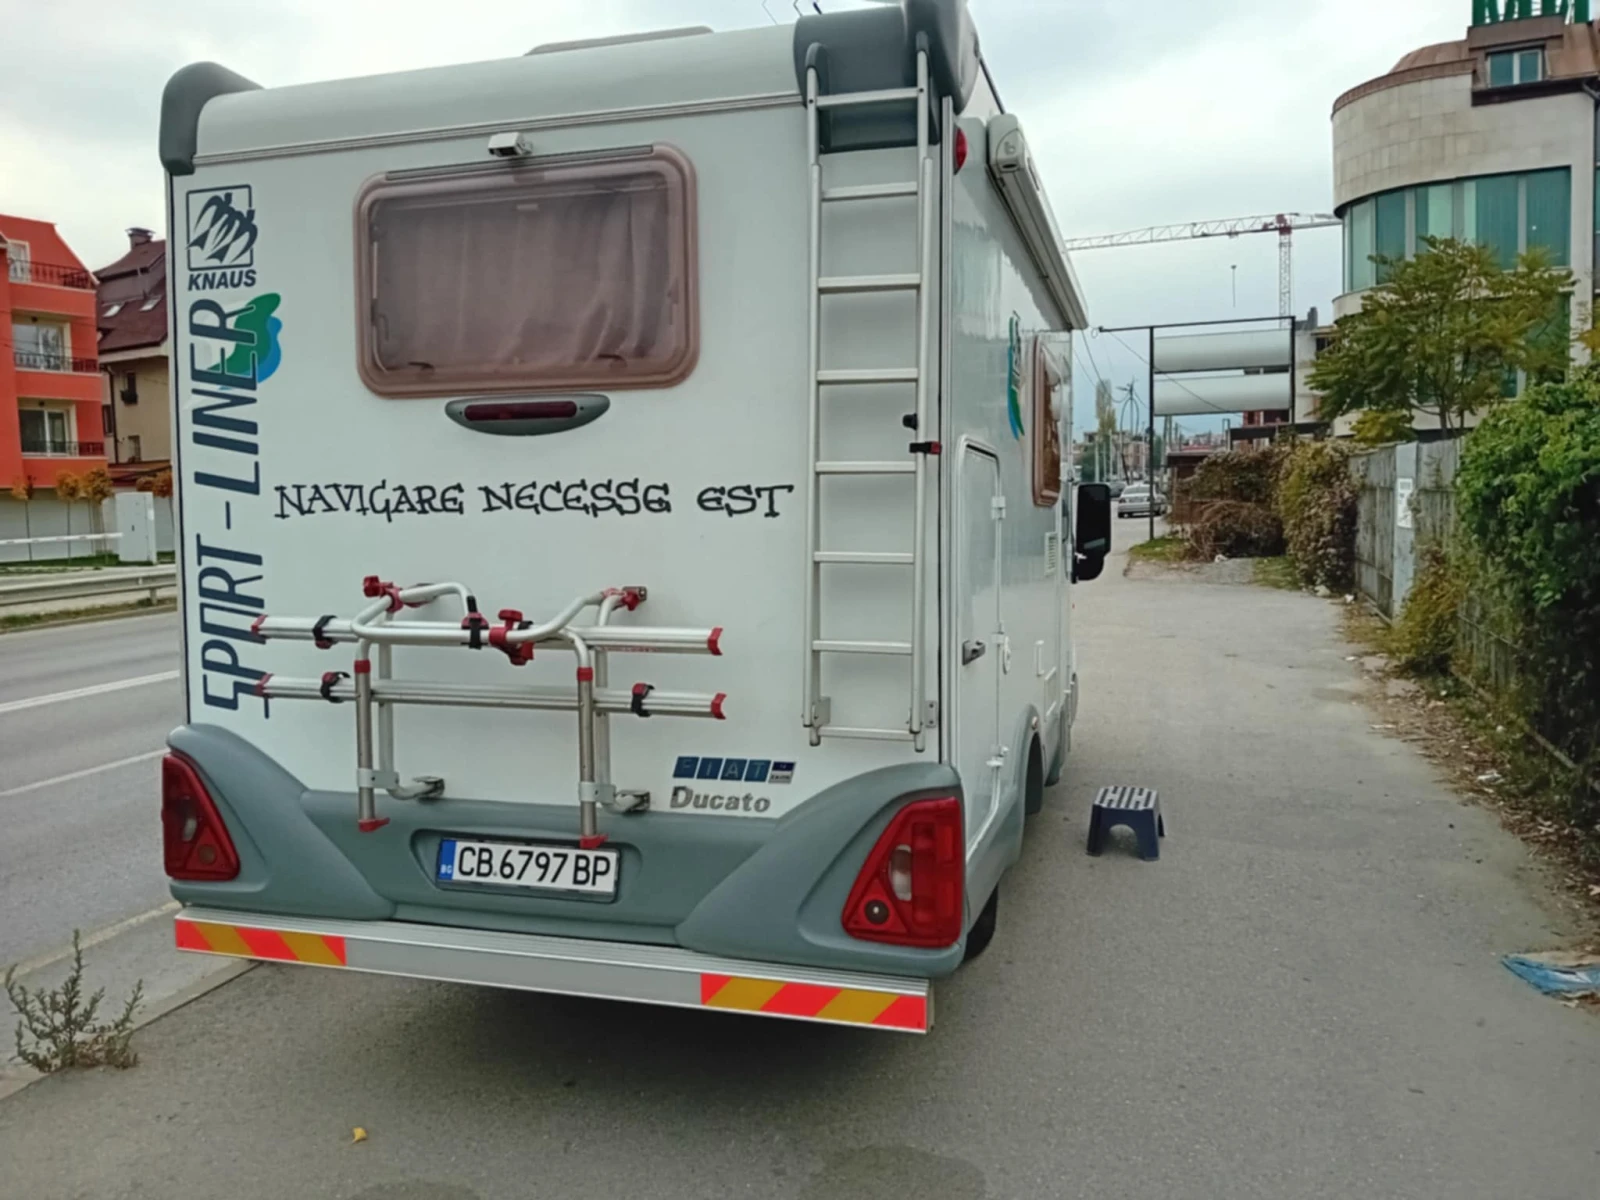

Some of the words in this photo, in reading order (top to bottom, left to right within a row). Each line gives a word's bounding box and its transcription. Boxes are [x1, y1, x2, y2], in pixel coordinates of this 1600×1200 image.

[188, 269, 257, 291] KNAUS
[274, 479, 464, 523] NAVIGARE
[478, 478, 672, 518] NECESSE
[697, 484, 794, 517] EST
[675, 757, 770, 781] FIAT
[670, 786, 771, 813] Ducato
[440, 864, 452, 874] BG
